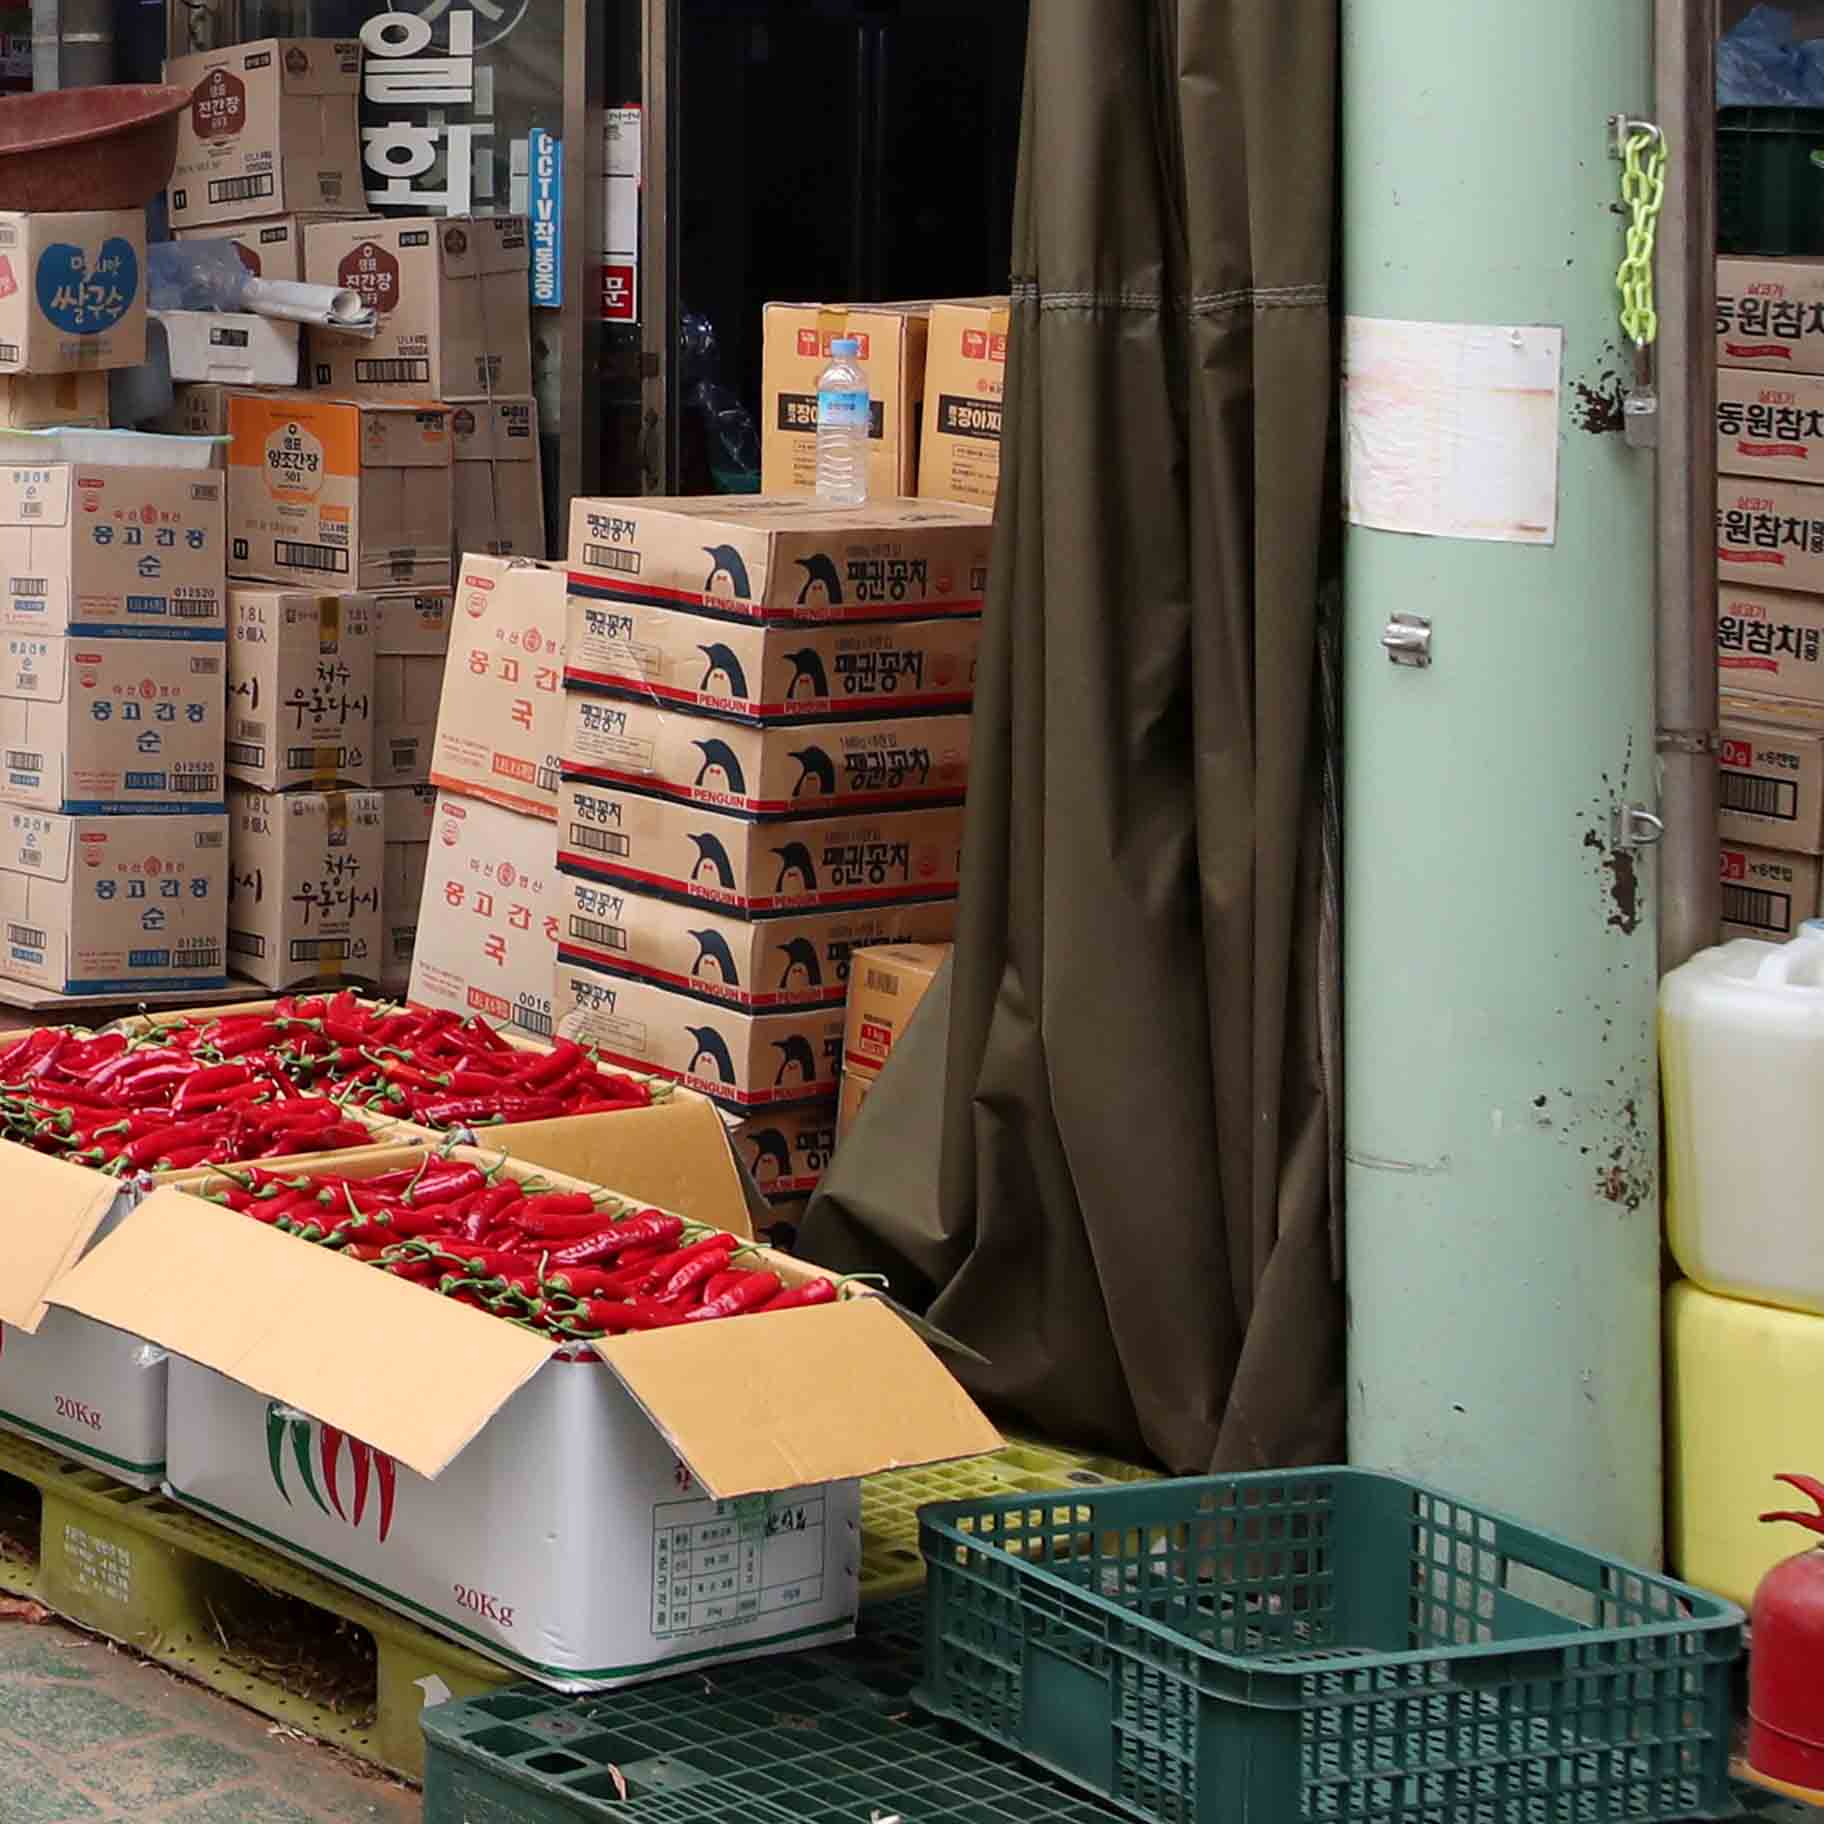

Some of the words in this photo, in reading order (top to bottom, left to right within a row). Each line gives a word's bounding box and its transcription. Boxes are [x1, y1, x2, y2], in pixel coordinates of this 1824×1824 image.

[199, 95, 240, 119] 진간장
[52, 283, 123, 325] 쌀국수
[267, 447, 320, 472] 양조간장
[90, 526, 206, 549] 몽고간장
[136, 554, 162, 577] 순
[704, 596, 752, 615] PENGUIN
[317, 662, 352, 687] 청수
[467, 648, 558, 694] 몽고간
[90, 700, 206, 723] 몽고간장
[285, 688, 369, 729] 우동다시
[511, 698, 534, 732] 국
[698, 694, 747, 713] PENGUIN
[136, 729, 162, 753] 순
[693, 789, 745, 808] PENGUIN
[325, 856, 361, 885] 청수
[95, 878, 210, 900] 몽고간장
[689, 885, 737, 906] PENGUIN
[290, 883, 380, 925] 우동다시
[141, 906, 165, 930] 순
[483, 933, 508, 969] 국
[689, 980, 740, 1002] PENGUIN
[685, 1077, 737, 1099] PENGUIN
[55, 1394, 102, 1431] 20Kg
[453, 1582, 515, 1627] 20Kg
